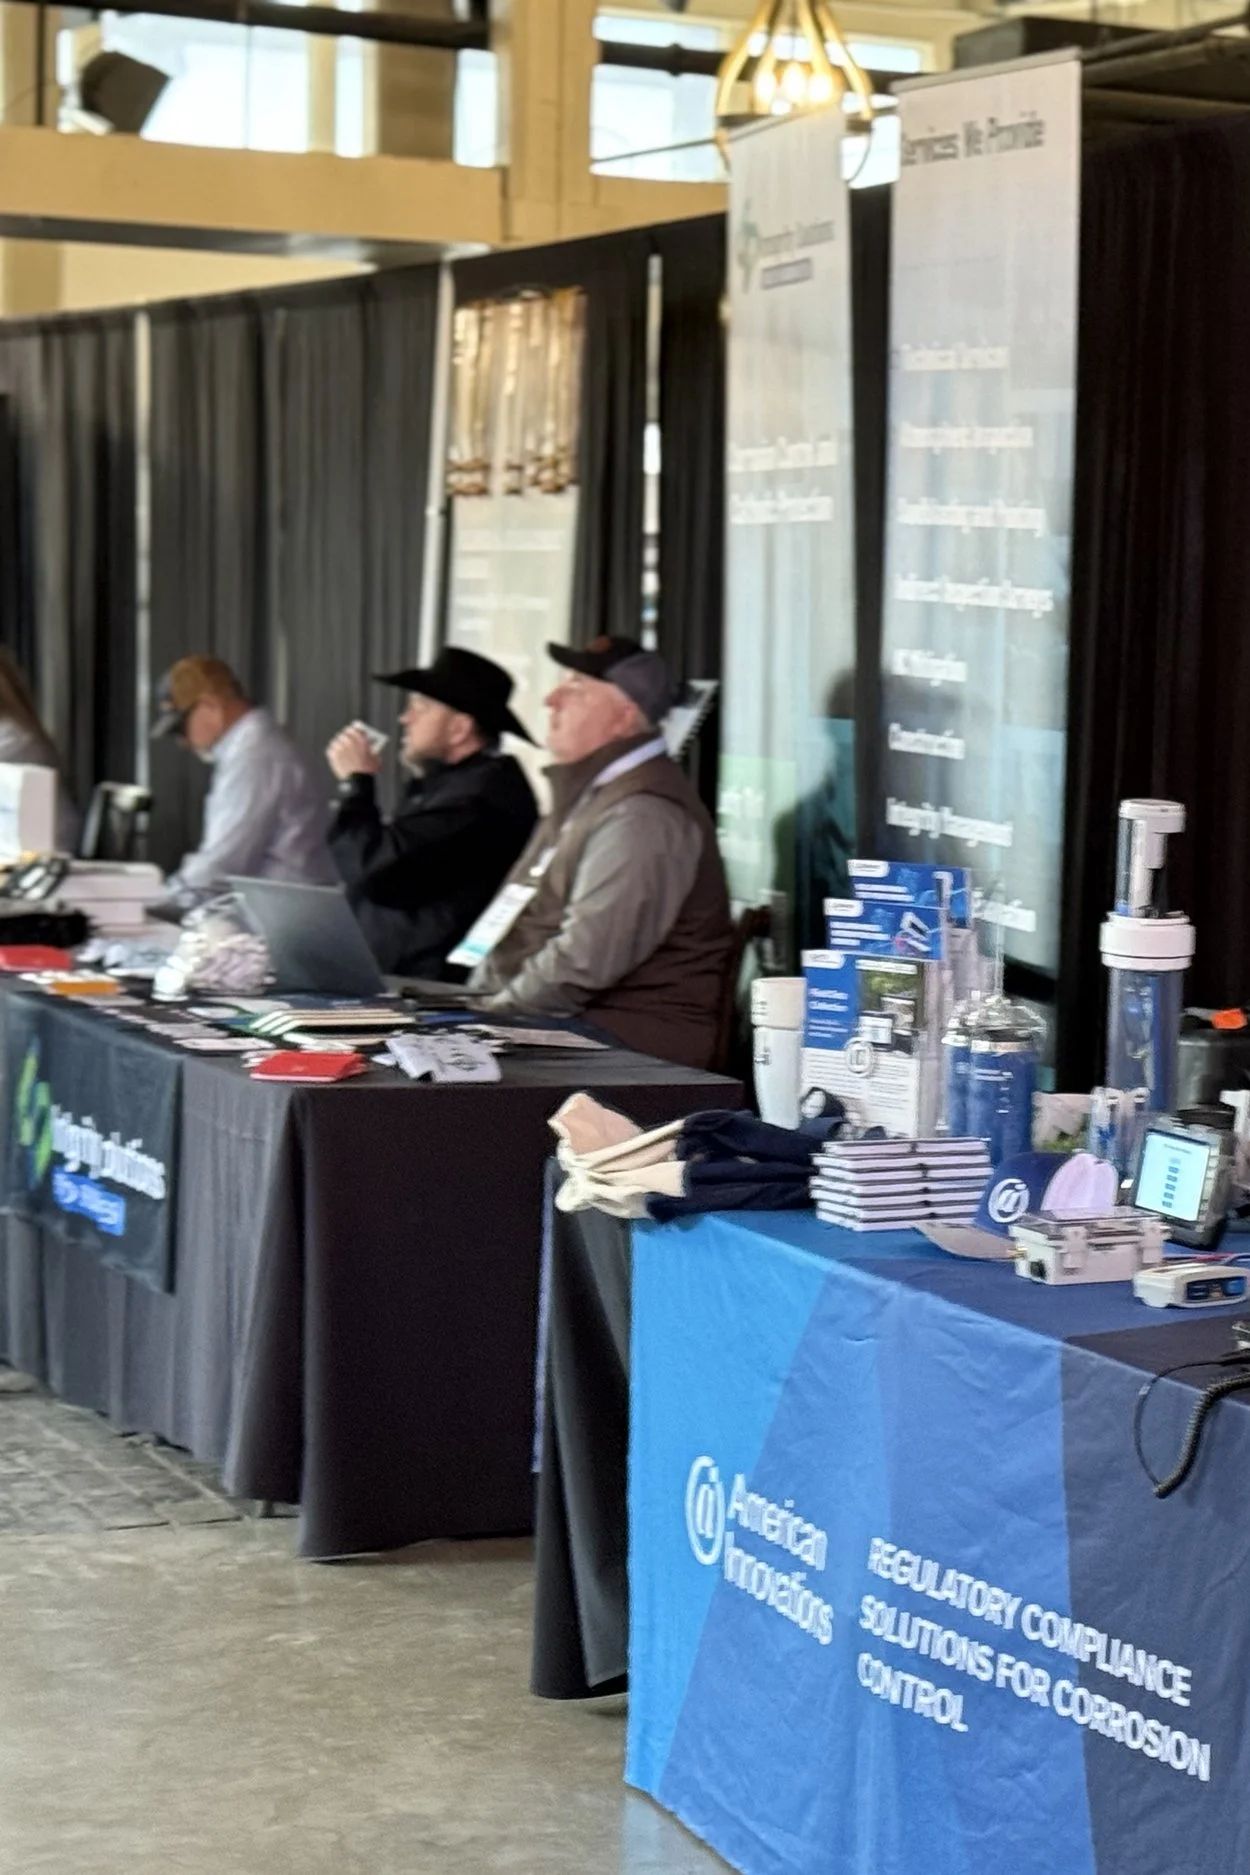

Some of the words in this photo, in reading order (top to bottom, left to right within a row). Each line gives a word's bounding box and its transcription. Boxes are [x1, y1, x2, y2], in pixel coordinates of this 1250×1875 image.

[727, 1473, 827, 1571] American
[724, 1531, 833, 1645] Innovations
[868, 1537, 1022, 1631] REGULATORY
[1021, 1603, 1191, 1707] COMPLIANCE
[857, 1652, 968, 1732] CONTROL
[860, 1595, 994, 1683] SOLUTIONS
[996, 1653, 1052, 1708] FOR
[1053, 1679, 1211, 1781] CORROSION
